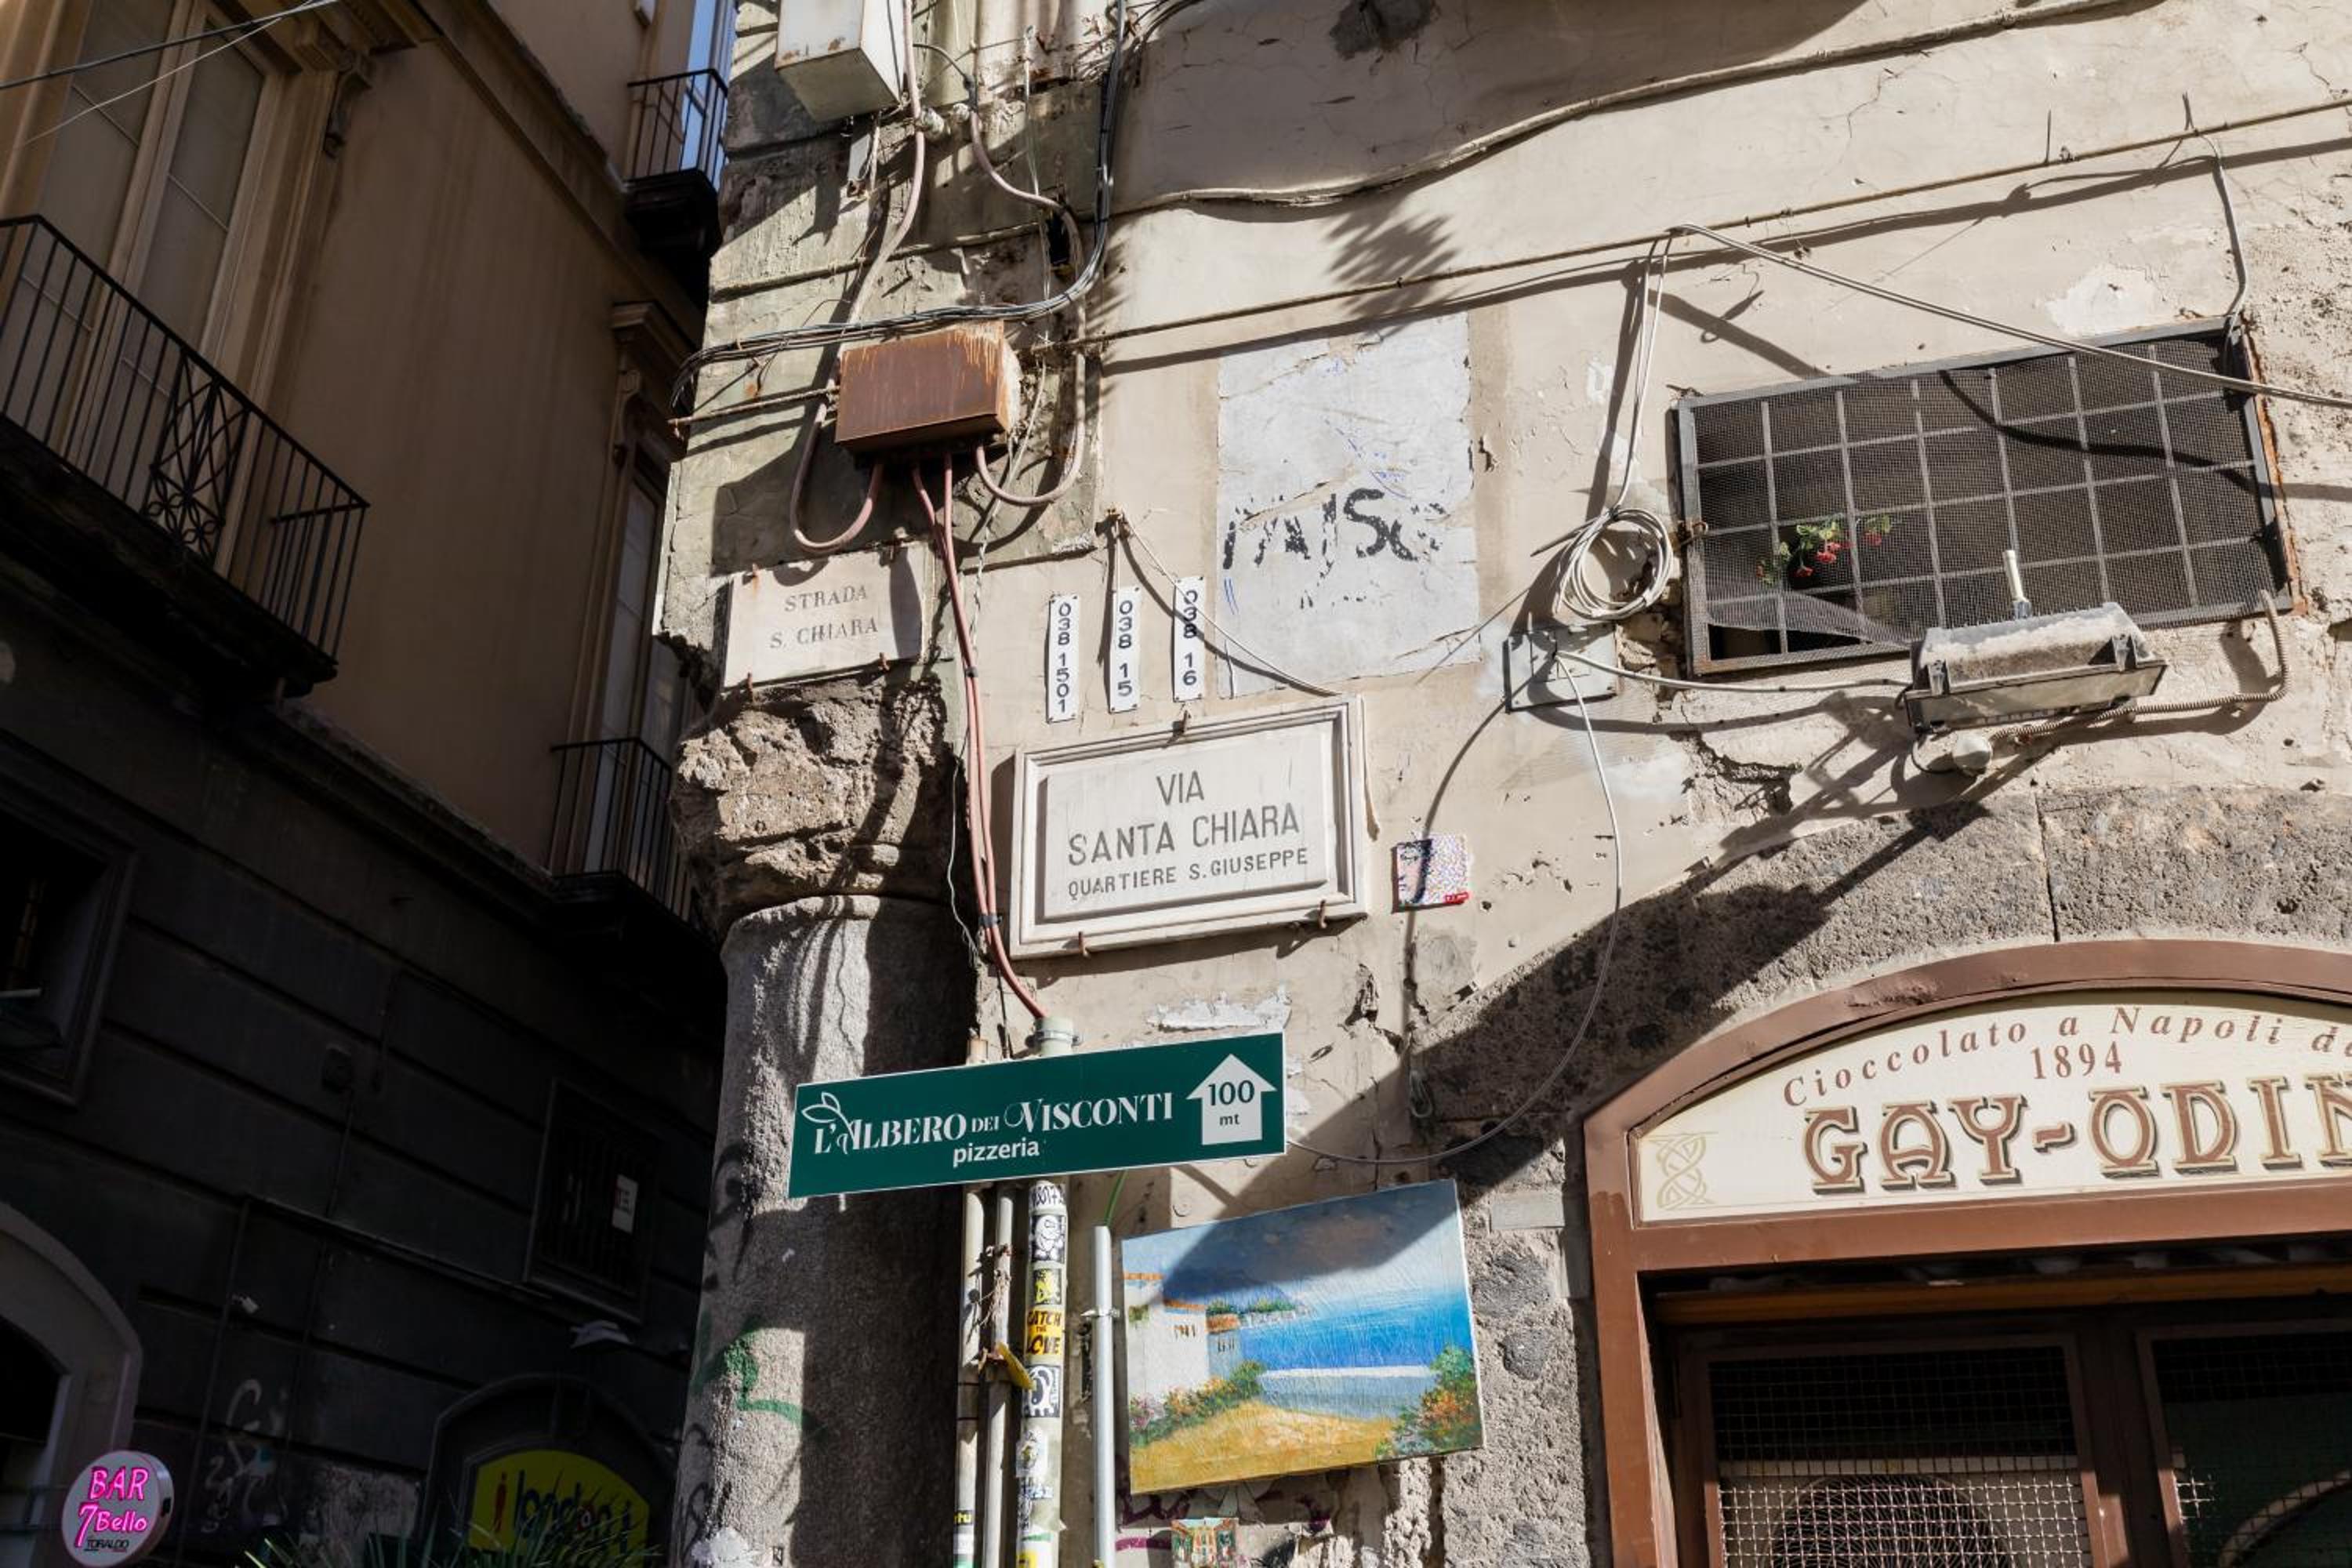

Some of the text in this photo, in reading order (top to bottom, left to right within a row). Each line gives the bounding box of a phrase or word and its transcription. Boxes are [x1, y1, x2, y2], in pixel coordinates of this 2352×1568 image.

[785, 585, 867, 612] STRADA
[797, 617, 879, 645] CHIARA
[1156, 770, 1205, 806] VIA
[1068, 802, 1301, 866] SANTA CHIARA
[1068, 866, 1176, 901] QUARTIERE
[1784, 1022, 2027, 1108] Cioccolato
[2058, 1011, 2079, 1036] a
[2109, 1005, 2282, 1046] Napoli
[2031, 1040, 2122, 1081] 1894
[1208, 1080, 1255, 1109] 100
[971, 1115, 1000, 1134] DEI
[1004, 1091, 1174, 1134] VISCONTI
[1219, 1112, 1240, 1126] mt
[953, 1135, 1040, 1167] pizzeria
[88, 1466, 150, 1501] BAR
